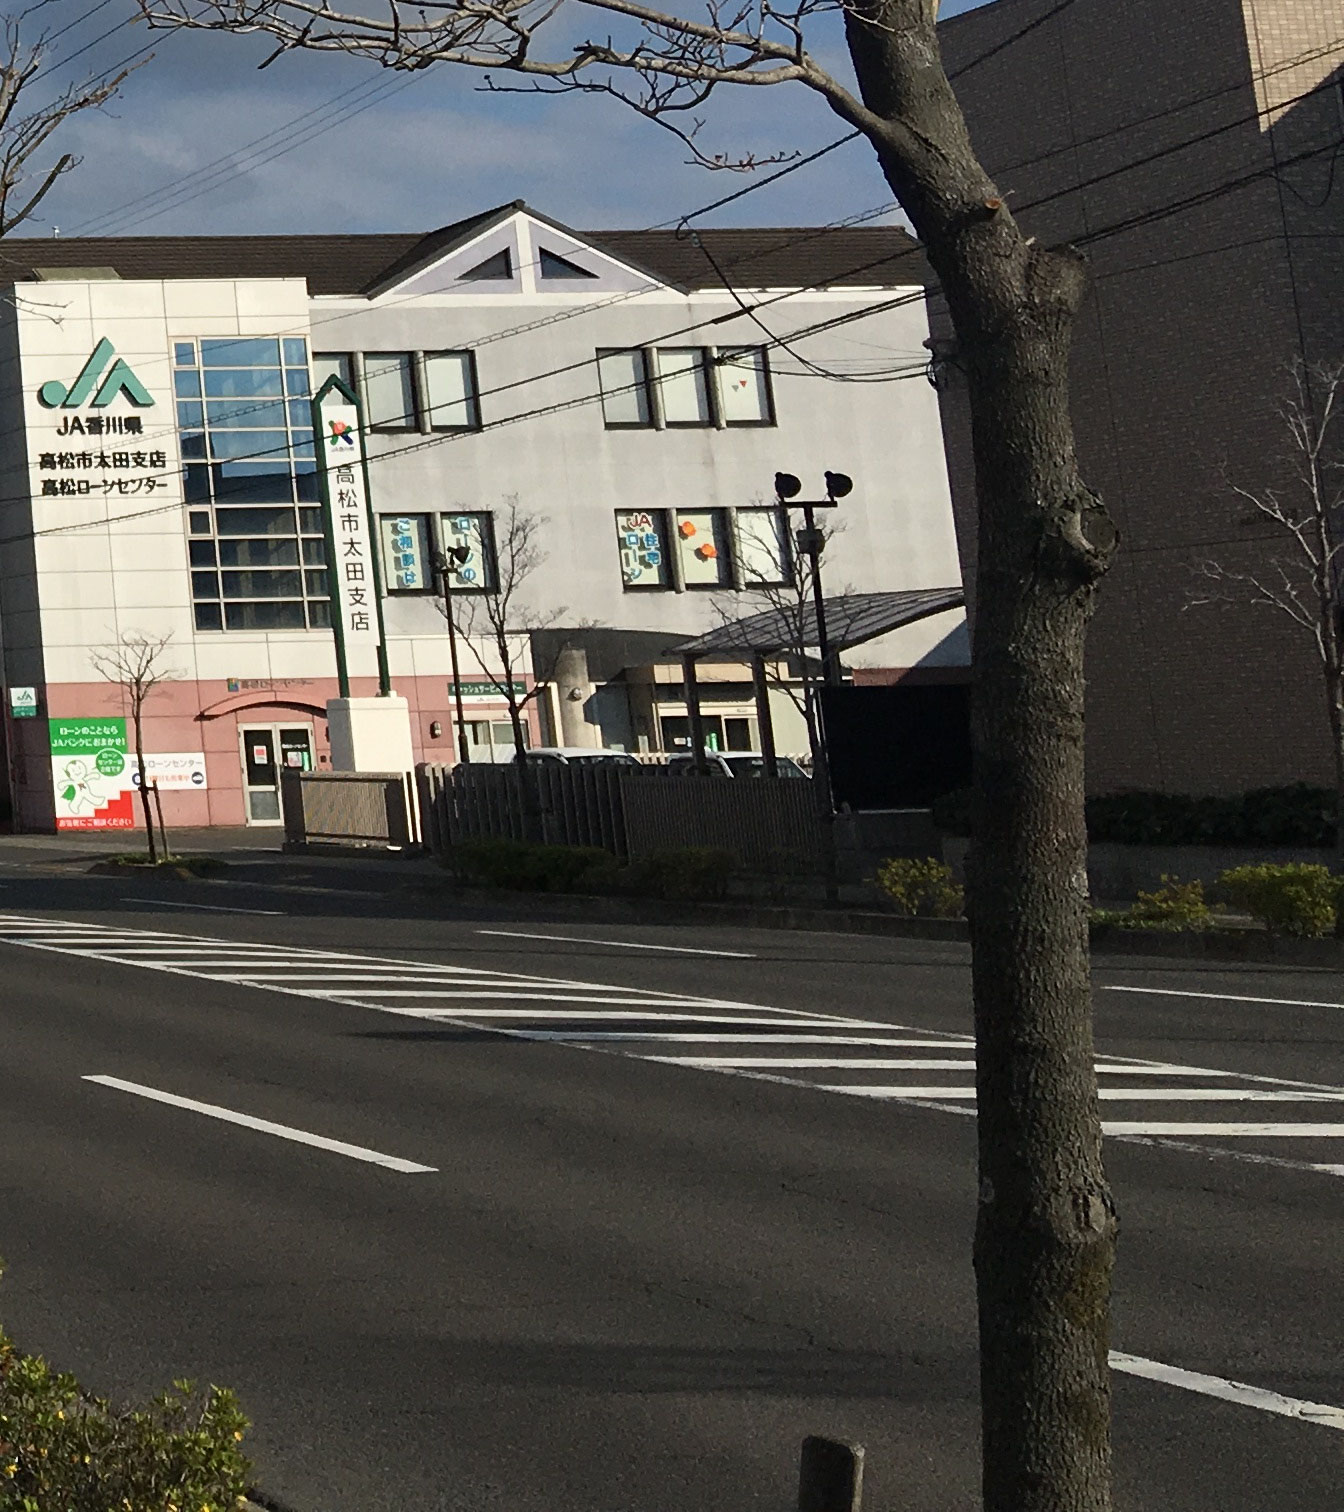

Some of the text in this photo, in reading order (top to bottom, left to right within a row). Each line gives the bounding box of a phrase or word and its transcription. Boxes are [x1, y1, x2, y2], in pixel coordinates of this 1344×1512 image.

[56, 416, 144, 436] JA香川県
[38, 450, 167, 471] 高松市太田支店
[40, 477, 168, 497] 高松ローンセンター
[628, 513, 654, 529] JA
[336, 465, 370, 632] 高松市太田支店
